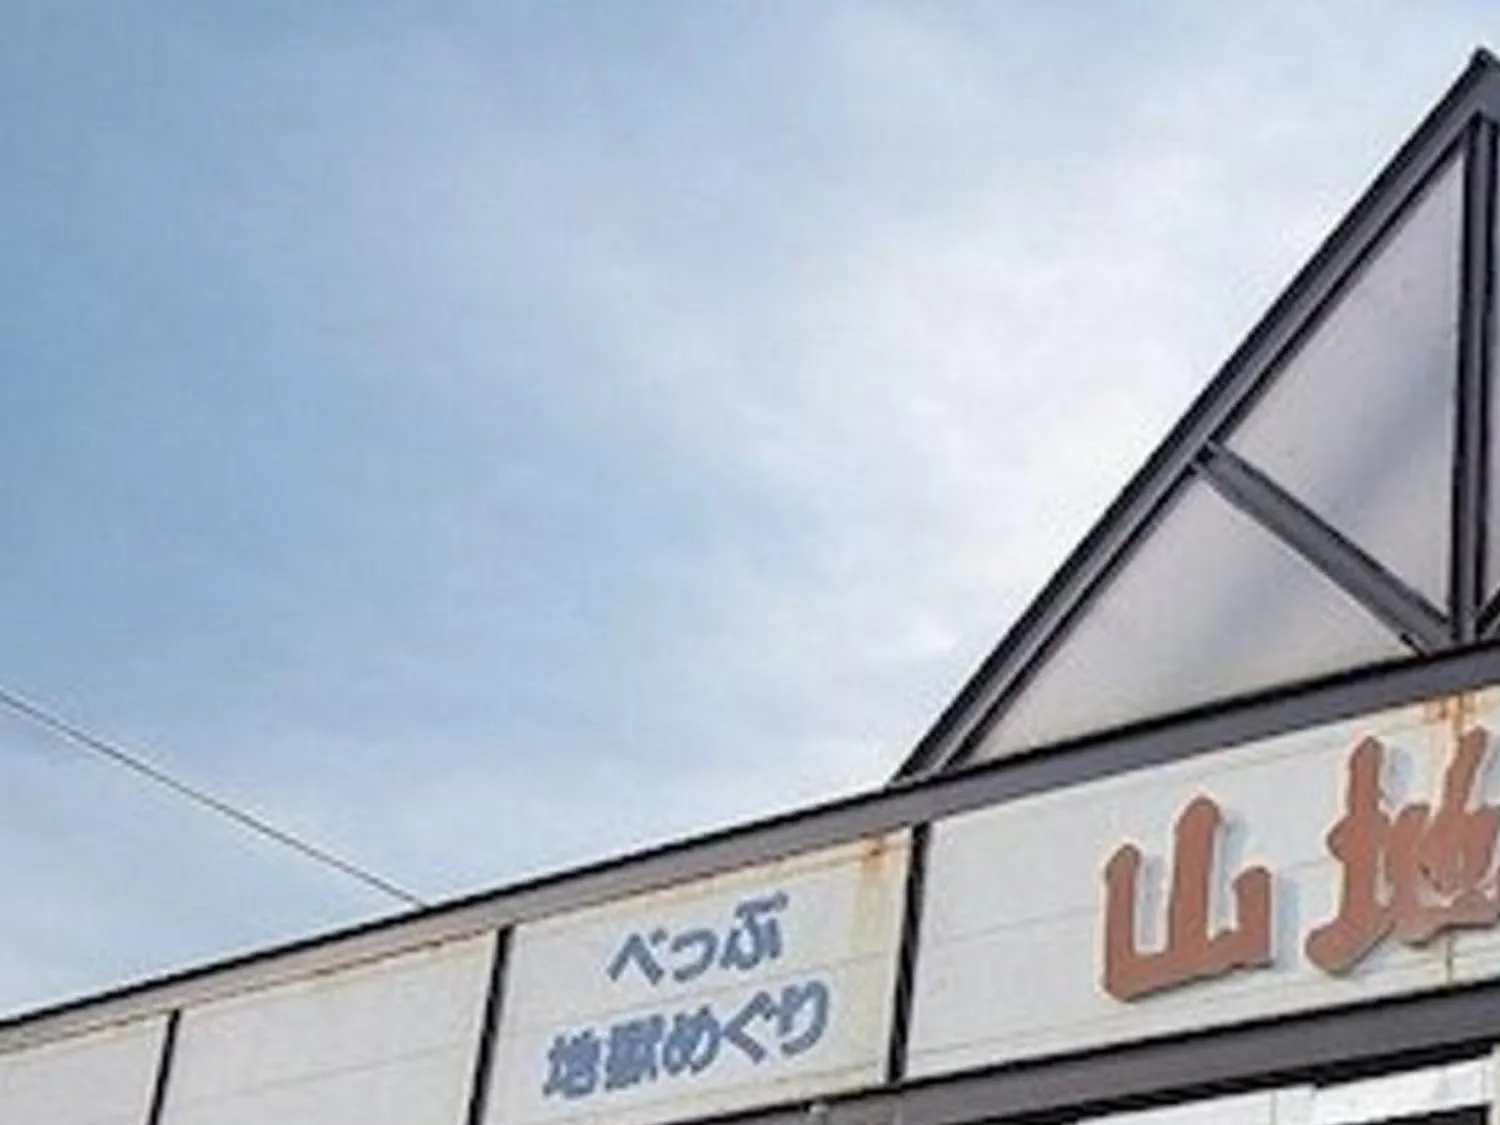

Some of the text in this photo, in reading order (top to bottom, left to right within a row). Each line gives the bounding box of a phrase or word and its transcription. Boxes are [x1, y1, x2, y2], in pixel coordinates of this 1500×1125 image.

[543, 979, 830, 1098] 地獄めぐり
